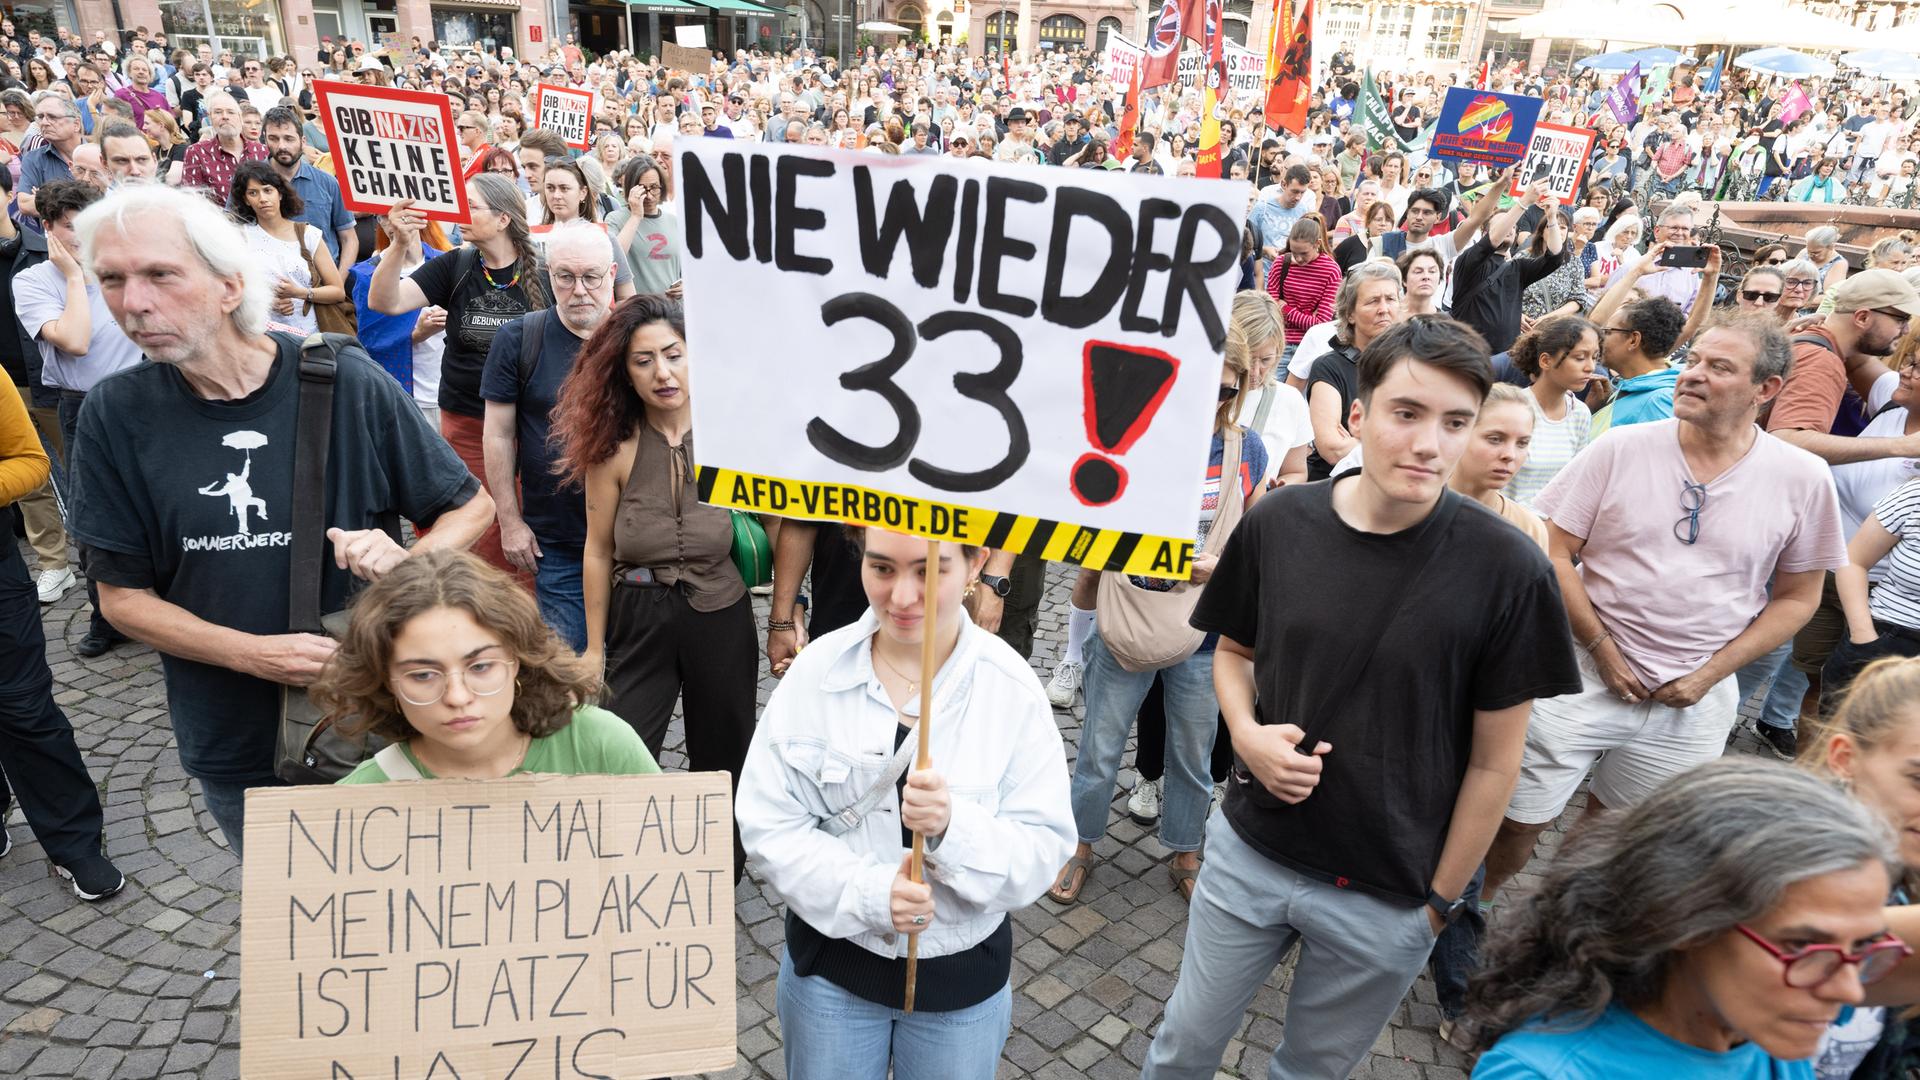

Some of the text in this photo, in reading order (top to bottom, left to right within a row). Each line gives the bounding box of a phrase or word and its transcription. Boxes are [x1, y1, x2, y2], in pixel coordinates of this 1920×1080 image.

[1111, 67, 1132, 84] AUC
[1241, 56, 1266, 71] SAG
[542, 108, 585, 128] KEINE
[544, 95, 586, 114] GIB NAZIS
[336, 106, 441, 144] GIB NAZIS
[343, 137, 448, 176] KEINE
[1532, 135, 1584, 158] GIB NAZIS
[1526, 152, 1579, 176] KEINE
[351, 169, 453, 204] CHANCE
[1521, 171, 1573, 193] CNCE
[646, 232, 672, 260] 2
[682, 152, 1241, 354] NIE WIEDER
[471, 315, 515, 327] DEBUNKIN
[731, 474, 969, 540] AFD-VERBOT.DE
[182, 531, 293, 552] SOMMERWERF
[288, 793, 727, 878] NICHT MAL AUF
[290, 869, 725, 960] MEINEM PLAKAT
[298, 941, 716, 1039] IST PLATZ FÜR
[332, 1029, 626, 1080] ZIS
